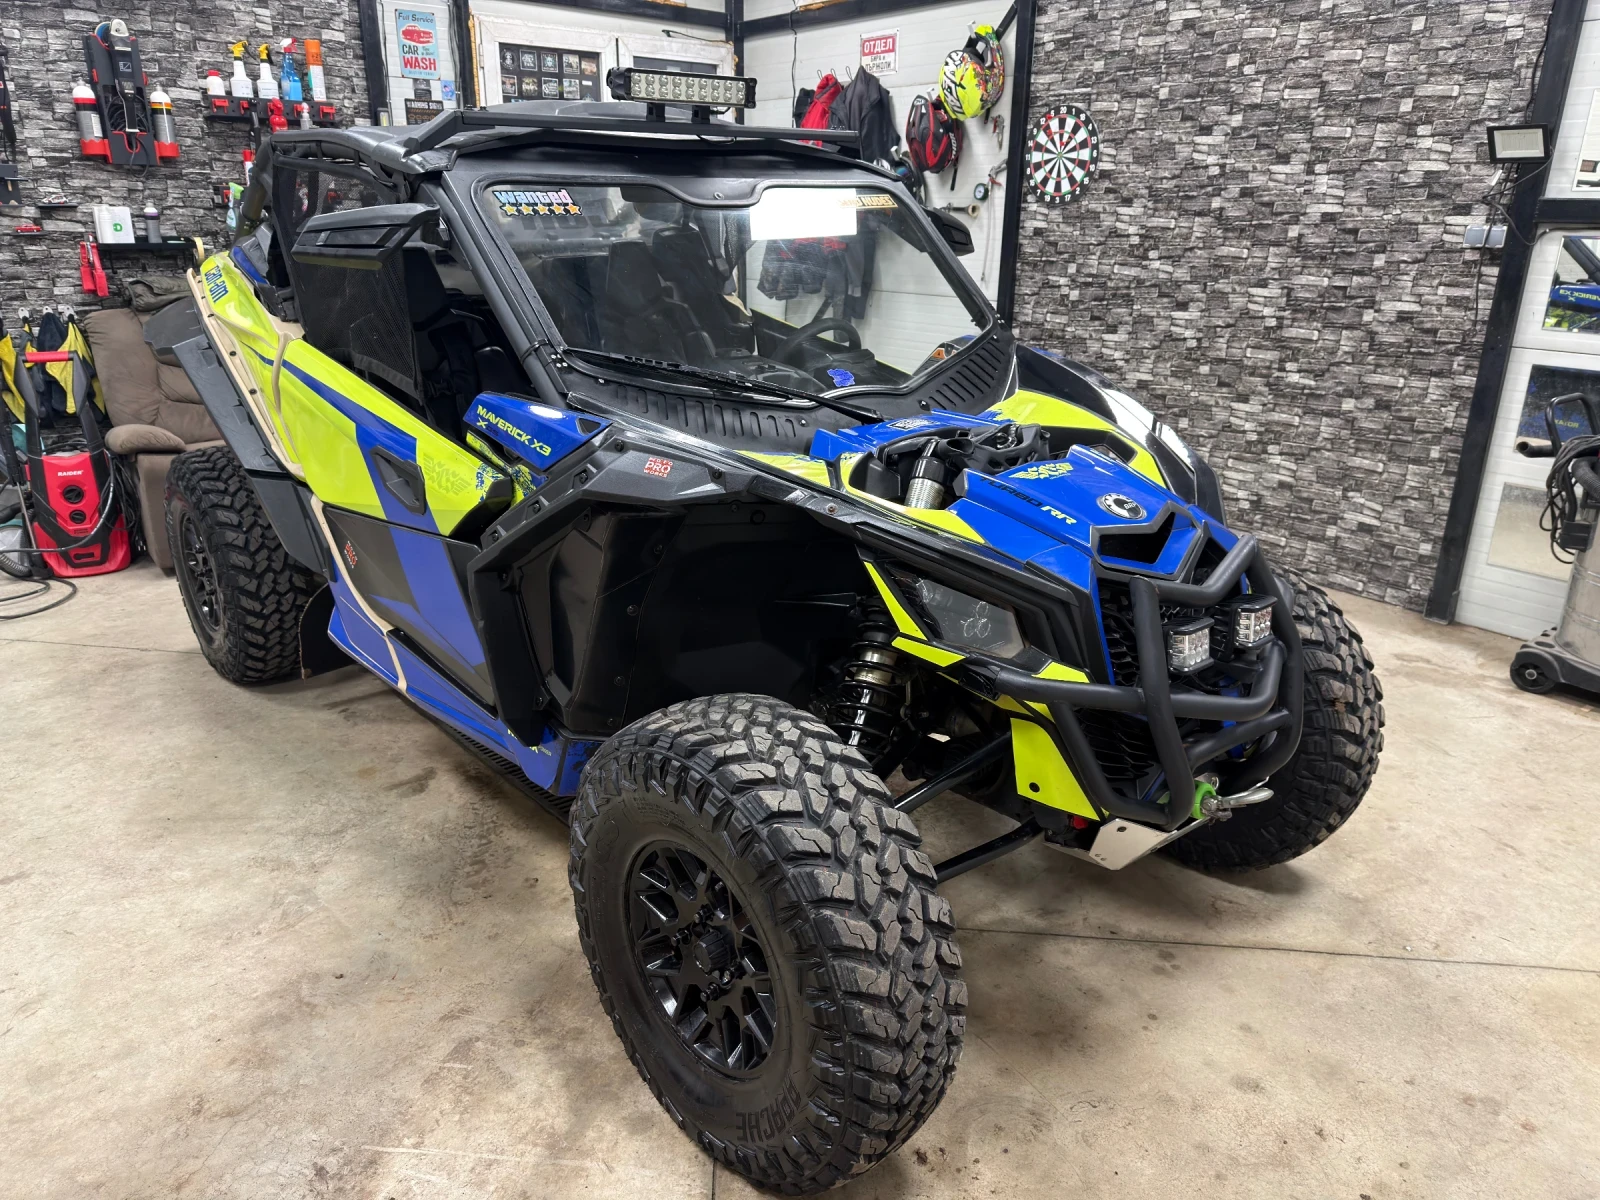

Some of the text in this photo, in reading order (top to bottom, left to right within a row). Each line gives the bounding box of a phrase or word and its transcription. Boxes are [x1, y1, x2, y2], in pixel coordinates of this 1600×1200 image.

[398, 12, 434, 24] Full Service
[402, 45, 419, 56] CAR
[864, 38, 893, 54] ОТДЕЛ
[402, 56, 437, 71] WASH
[1060, 106, 1067, 114] 20
[1090, 164, 1096, 172] 10
[493, 188, 574, 204] wanted
[861, 196, 894, 207] NUDES
[1044, 194, 1051, 202] 19
[476, 417, 489, 429] X
[477, 405, 552, 457] MAVERICK X3
[643, 469, 668, 478] WORKS
[645, 461, 671, 474] PRO
[980, 476, 1078, 526] TURBO RR
